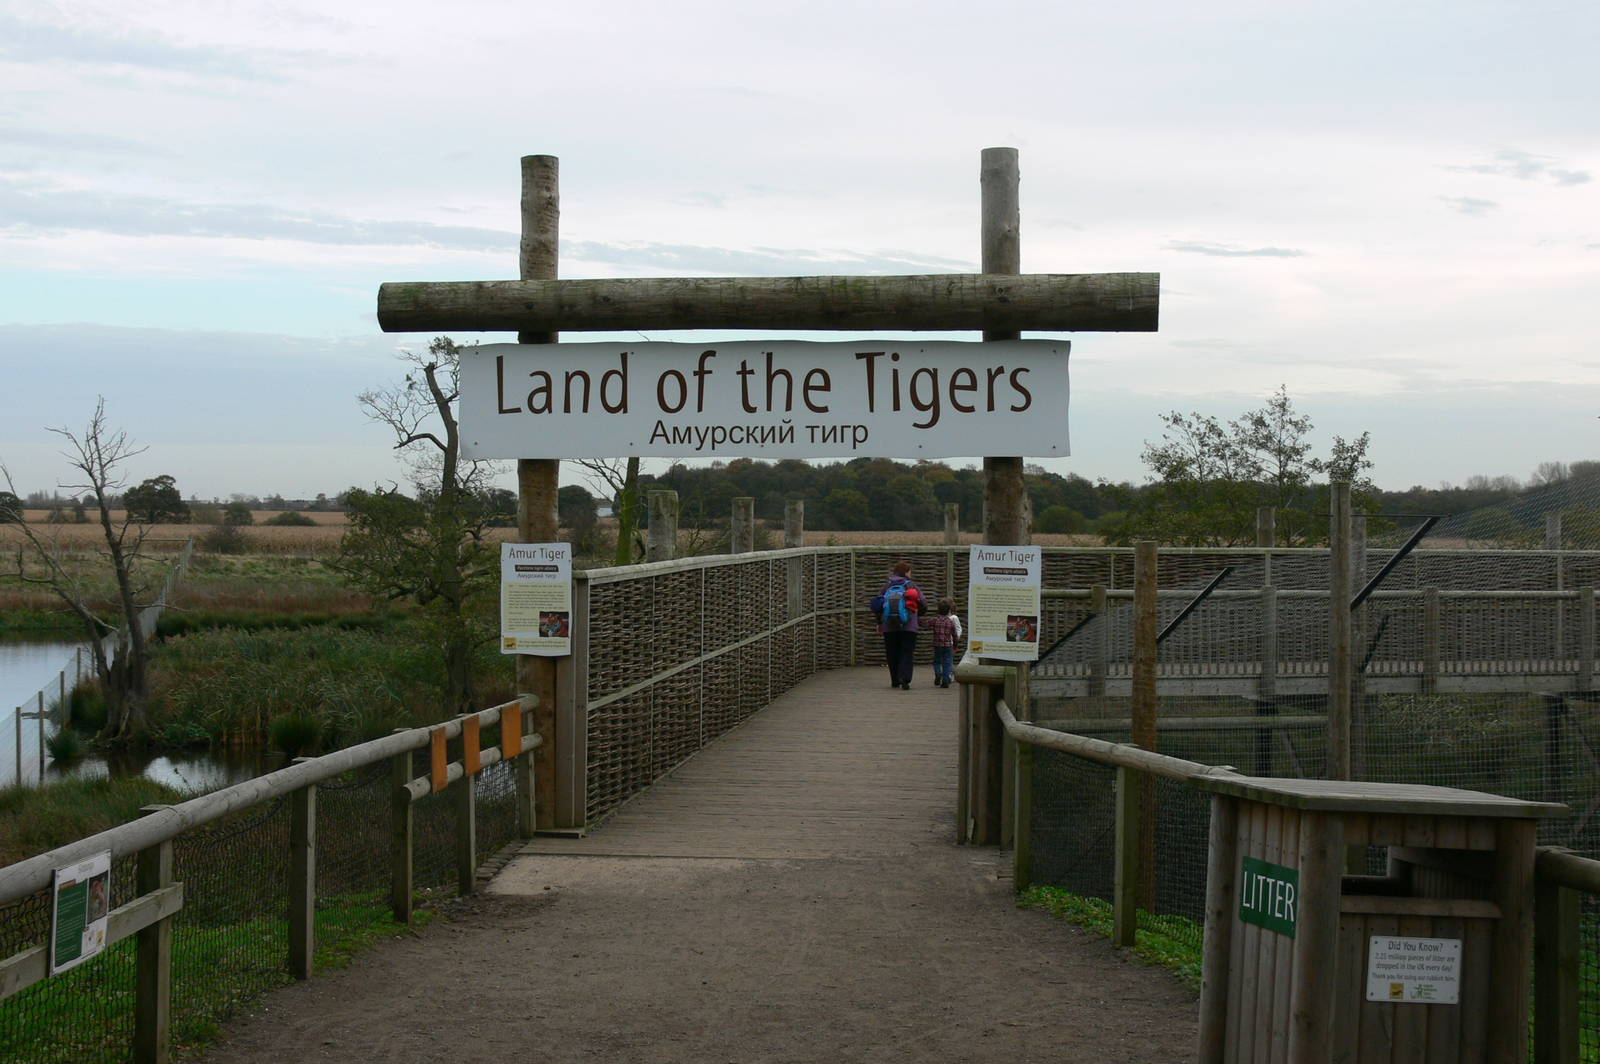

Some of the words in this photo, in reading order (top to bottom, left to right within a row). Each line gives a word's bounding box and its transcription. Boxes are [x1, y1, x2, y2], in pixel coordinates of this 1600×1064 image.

[496, 352, 630, 415] Land
[656, 350, 718, 415] of
[736, 351, 832, 415] the
[855, 351, 1033, 429] Tigers
[649, 419, 796, 451] Амурский
[805, 424, 870, 450] тигр
[509, 547, 537, 559] Amur
[540, 547, 566, 561] Tiger
[977, 549, 1006, 561] Amur
[1008, 550, 1035, 565] Tiger
[1242, 871, 1295, 922] LITTER
[1388, 940, 1401, 951] Did
[1403, 942, 1416, 952] You
[1418, 942, 1444, 952] Know?
[1407, 954, 1424, 962] pieces
[1376, 962, 1400, 971] dropped
